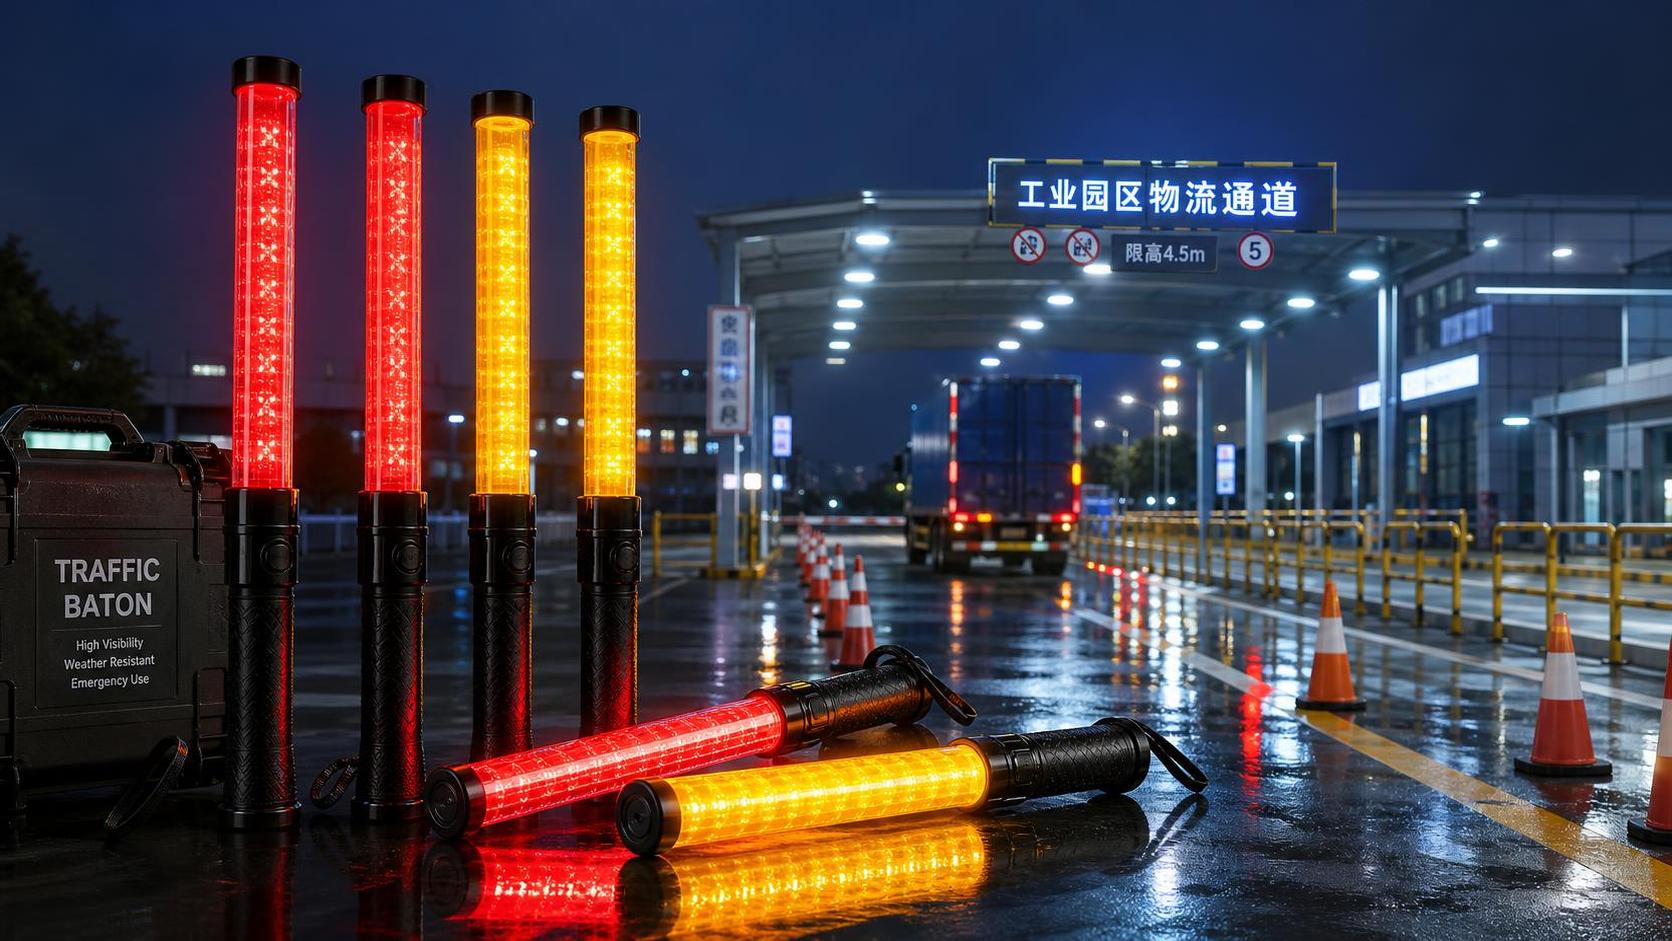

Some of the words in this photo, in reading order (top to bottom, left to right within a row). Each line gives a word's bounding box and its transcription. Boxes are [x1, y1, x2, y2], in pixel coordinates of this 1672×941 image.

[1018, 178, 1298, 217] 工业园区物流通道
[1125, 242, 1206, 264] 限高4.5m
[1249, 241, 1261, 261] 5
[54, 557, 160, 583] TRAFFIC
[64, 592, 152, 618] BATON
[76, 639, 100, 653] High
[102, 637, 144, 651] Visibility
[64, 658, 108, 670] Weather
[109, 654, 155, 668] Resistant
[71, 676, 129, 690] Emergency
[130, 673, 150, 685] Use
